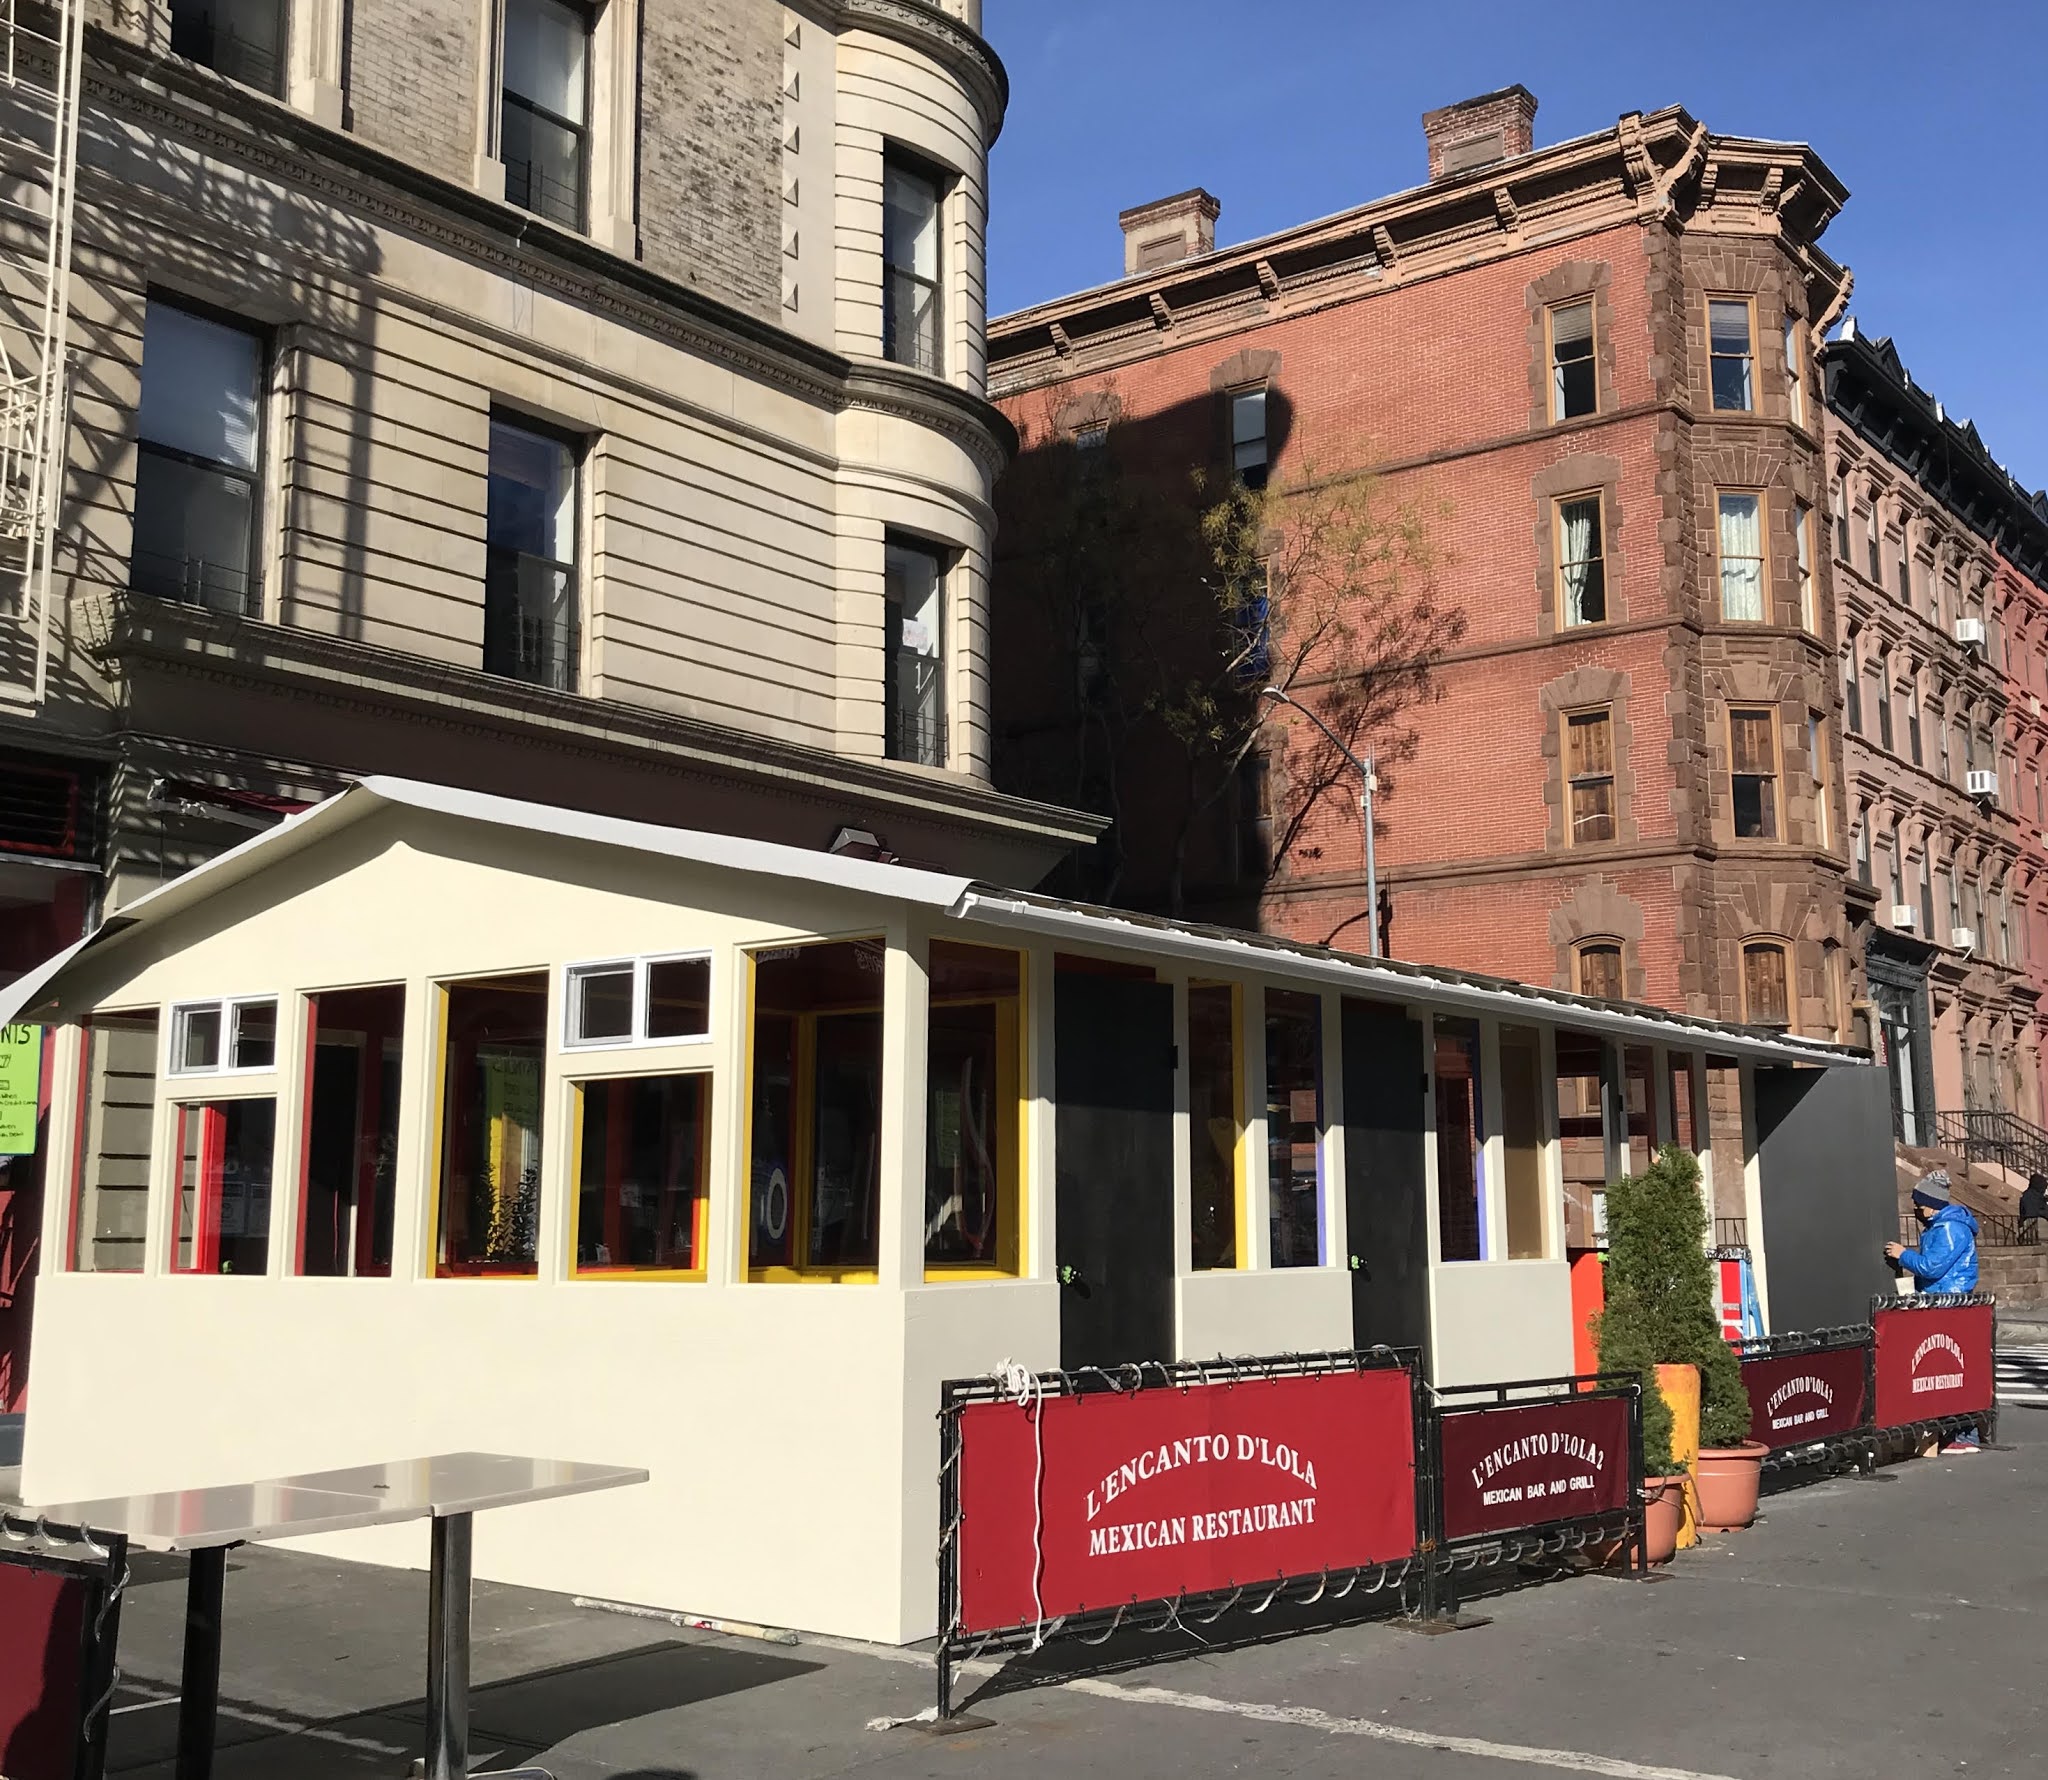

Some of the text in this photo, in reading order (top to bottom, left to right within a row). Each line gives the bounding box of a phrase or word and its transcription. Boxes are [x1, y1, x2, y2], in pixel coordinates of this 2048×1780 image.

[1766, 1376, 1804, 1417] L'ENCANTO
[1772, 1408, 1829, 1430] MEXICAN BAR AND GRILL
[1086, 1433, 1318, 1522] L'ENCANTO D'LOLA
[1471, 1432, 1605, 1489] L'ENCANTO D'LOLA2
[1483, 1475, 1595, 1506] MEXICAN BAR AND GRILL
[1089, 1497, 1316, 1557] MEXICAN RESTAURANT
